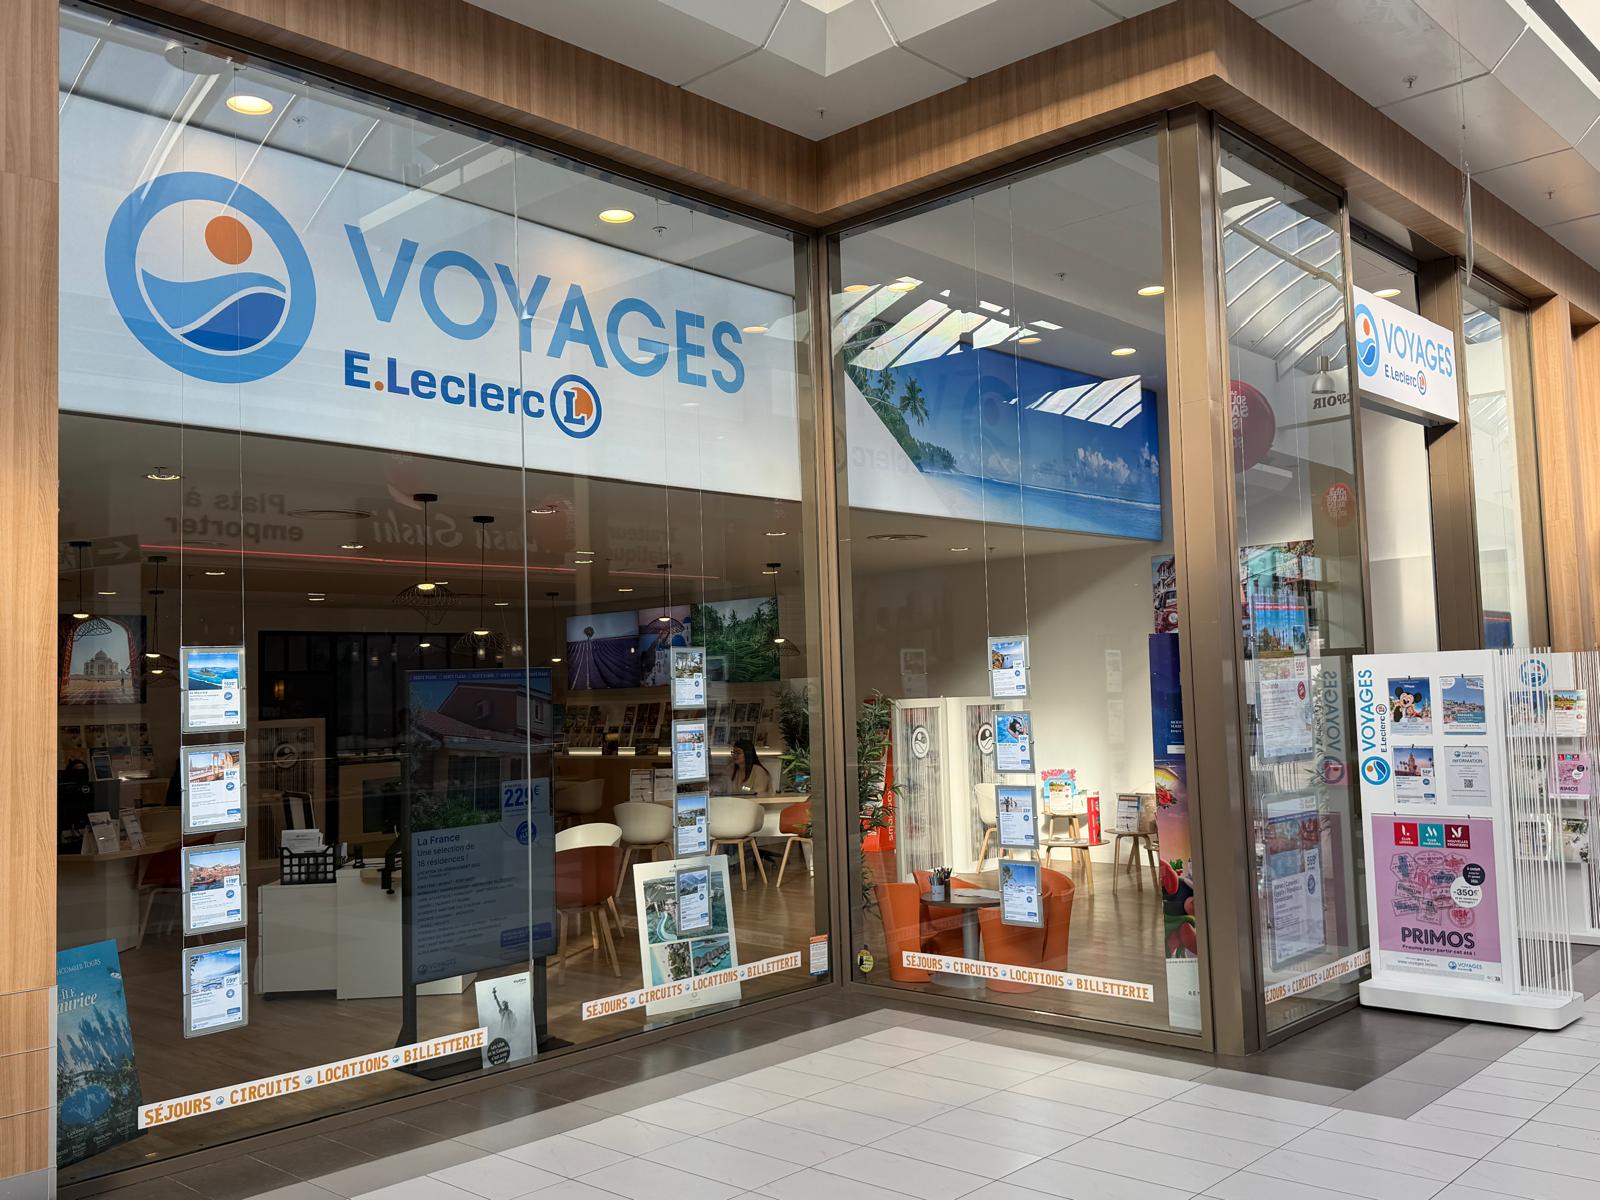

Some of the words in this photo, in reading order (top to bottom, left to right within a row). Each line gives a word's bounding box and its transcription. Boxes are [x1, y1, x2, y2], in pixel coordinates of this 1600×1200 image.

[344, 225, 746, 394] VOYAGES
[1381, 318, 1453, 378] VOYAGES
[344, 350, 546, 419] E.Leclerc
[1384, 363, 1418, 389] E.Leclerc
[1358, 669, 1377, 752] VOYAGES
[417, 834, 428, 846] La
[430, 833, 460, 845] France
[417, 847, 432, 857] Une
[433, 843, 464, 855] sélection
[427, 855, 465, 867] résidences
[1401, 927, 1475, 949] PRIMOS
[586, 997, 628, 1018] SÉJOURS
[638, 985, 683, 1005] CIRCUITS
[692, 970, 738, 991] LOCATIONS
[747, 955, 799, 978] BILLETTERIE
[906, 953, 943, 970] SÉJOURS
[953, 961, 999, 977] CIRCUITS
[1009, 968, 1064, 987] LOCATIONS
[1076, 978, 1149, 1000] BILLETTERIE
[1292, 973, 1318, 992] CIRCUITS
[1323, 961, 1350, 981] LOCATIONS
[57, 992, 97, 1015] aurice
[144, 1096, 211, 1126] SÉJOURS
[230, 1075, 301, 1105] CIRCUITS
[317, 1054, 389, 1084] LOCATIONS
[404, 1031, 484, 1063] BILLETTERIE
